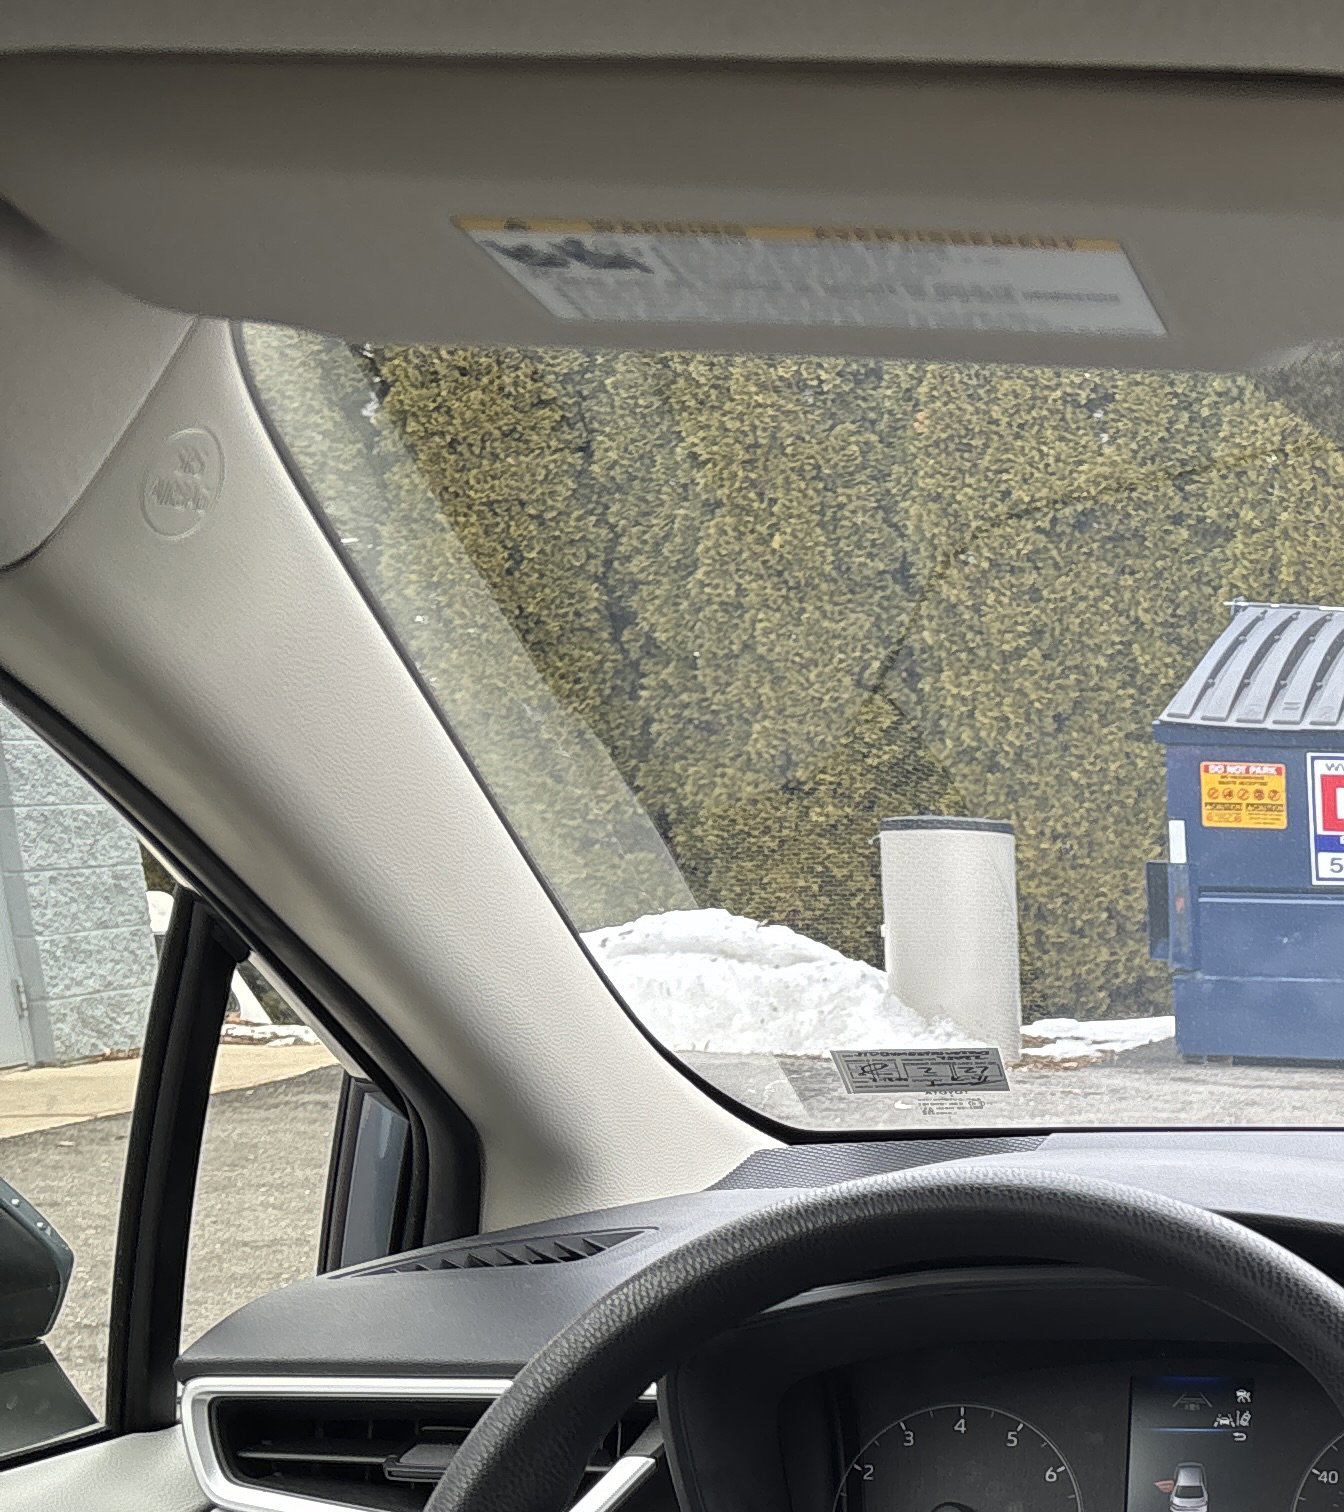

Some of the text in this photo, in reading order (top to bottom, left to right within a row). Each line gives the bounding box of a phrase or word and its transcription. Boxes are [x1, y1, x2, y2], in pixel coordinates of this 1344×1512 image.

[954, 1419, 966, 1434] 4
[904, 1431, 914, 1447] 3
[1006, 1431, 1018, 1447] 5
[863, 1465, 874, 1481] 2
[1045, 1466, 1057, 1482] 6
[1317, 1470, 1339, 1484] 40
